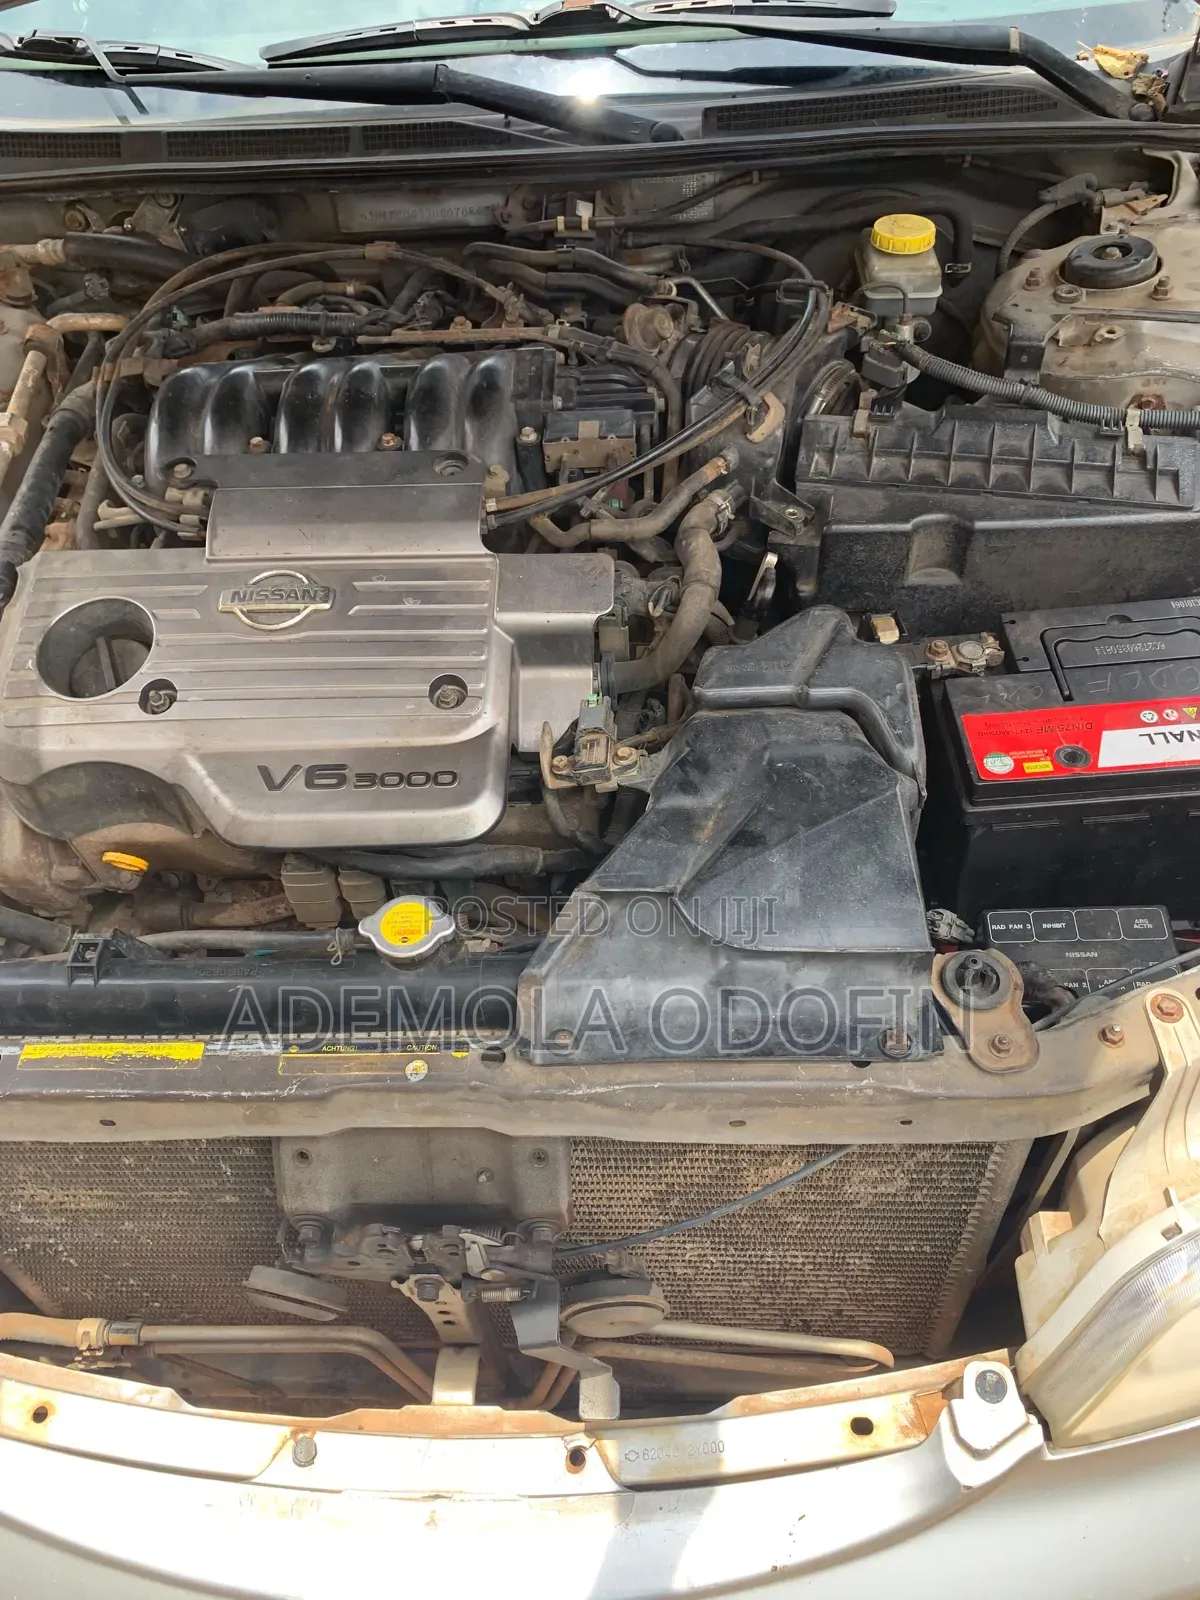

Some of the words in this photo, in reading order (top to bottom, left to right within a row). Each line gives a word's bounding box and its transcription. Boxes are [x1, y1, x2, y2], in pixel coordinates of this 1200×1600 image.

[230, 587, 318, 603] NISSAN
[1037, 725, 1054, 734] MF
[257, 763, 349, 791] V6
[352, 771, 459, 790] 3000
[642, 1445, 679, 1461] 62040
[688, 1440, 725, 1456] 2Y000
